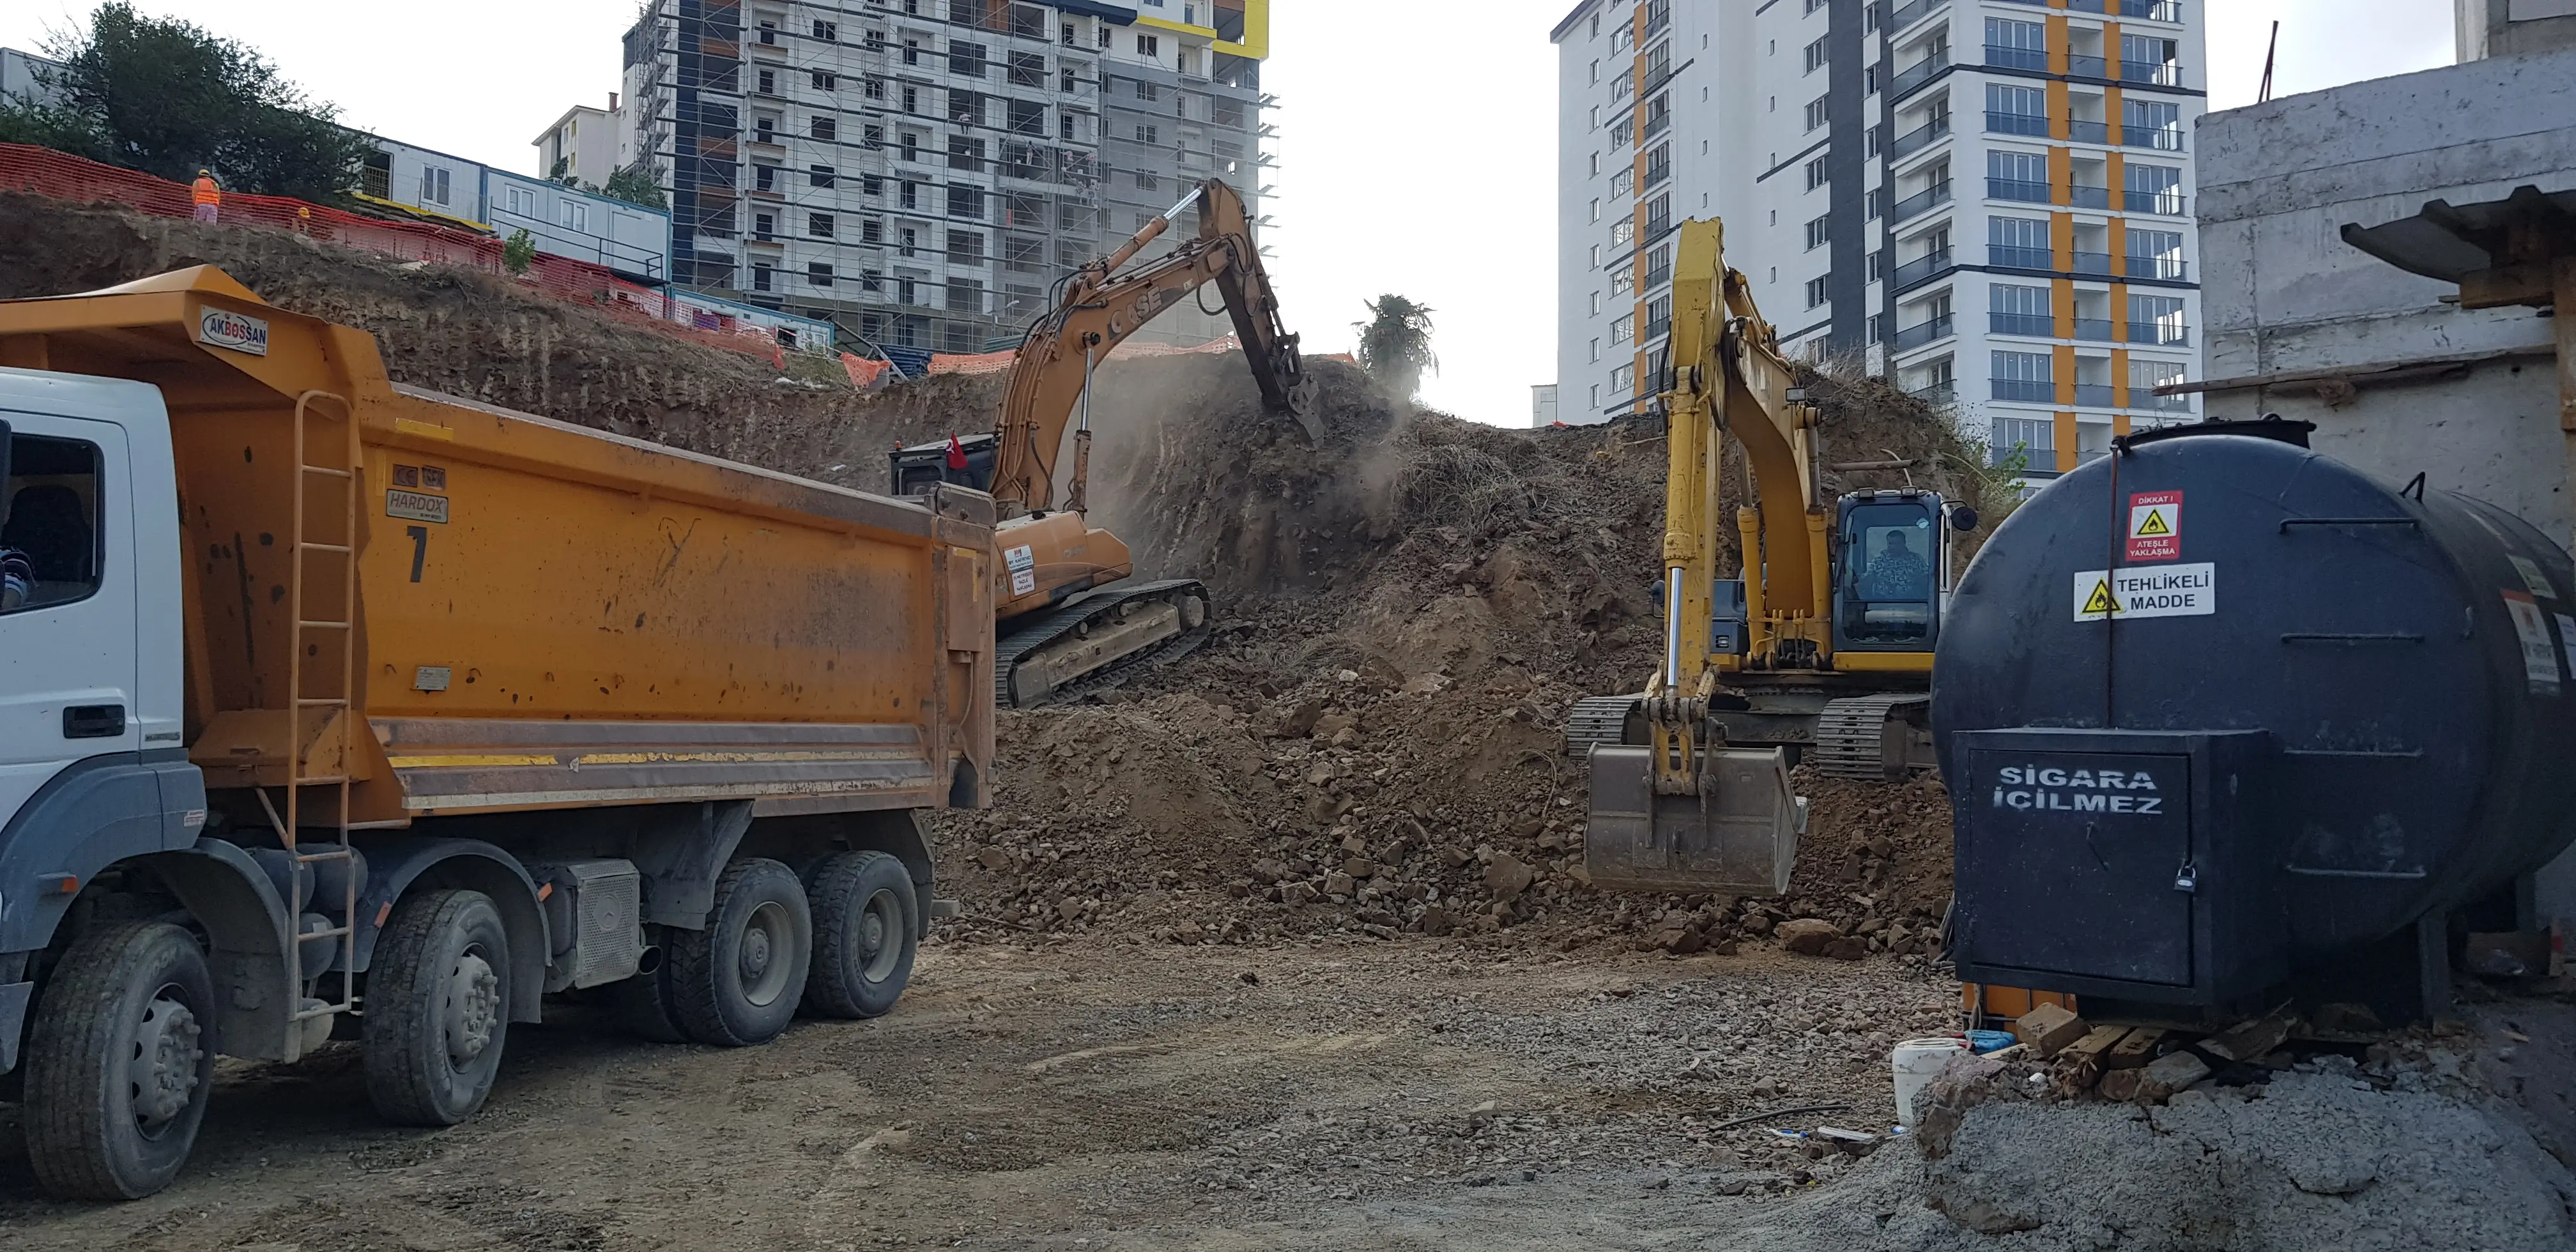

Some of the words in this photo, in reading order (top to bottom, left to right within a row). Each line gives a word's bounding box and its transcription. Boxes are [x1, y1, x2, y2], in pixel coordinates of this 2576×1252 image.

[210, 317, 266, 344] AKBOSSAN
[390, 492, 443, 513] HARDOX
[2138, 495, 2168, 504] DİKKAT
[406, 526, 427, 583] 7
[2129, 548, 2175, 556] YAKLAŞMA
[2136, 540, 2168, 548] ATEŞLE
[2117, 571, 2209, 592] TEHLİKELİ
[2131, 594, 2196, 610] MADDE
[2000, 763, 2157, 790] SİGARA
